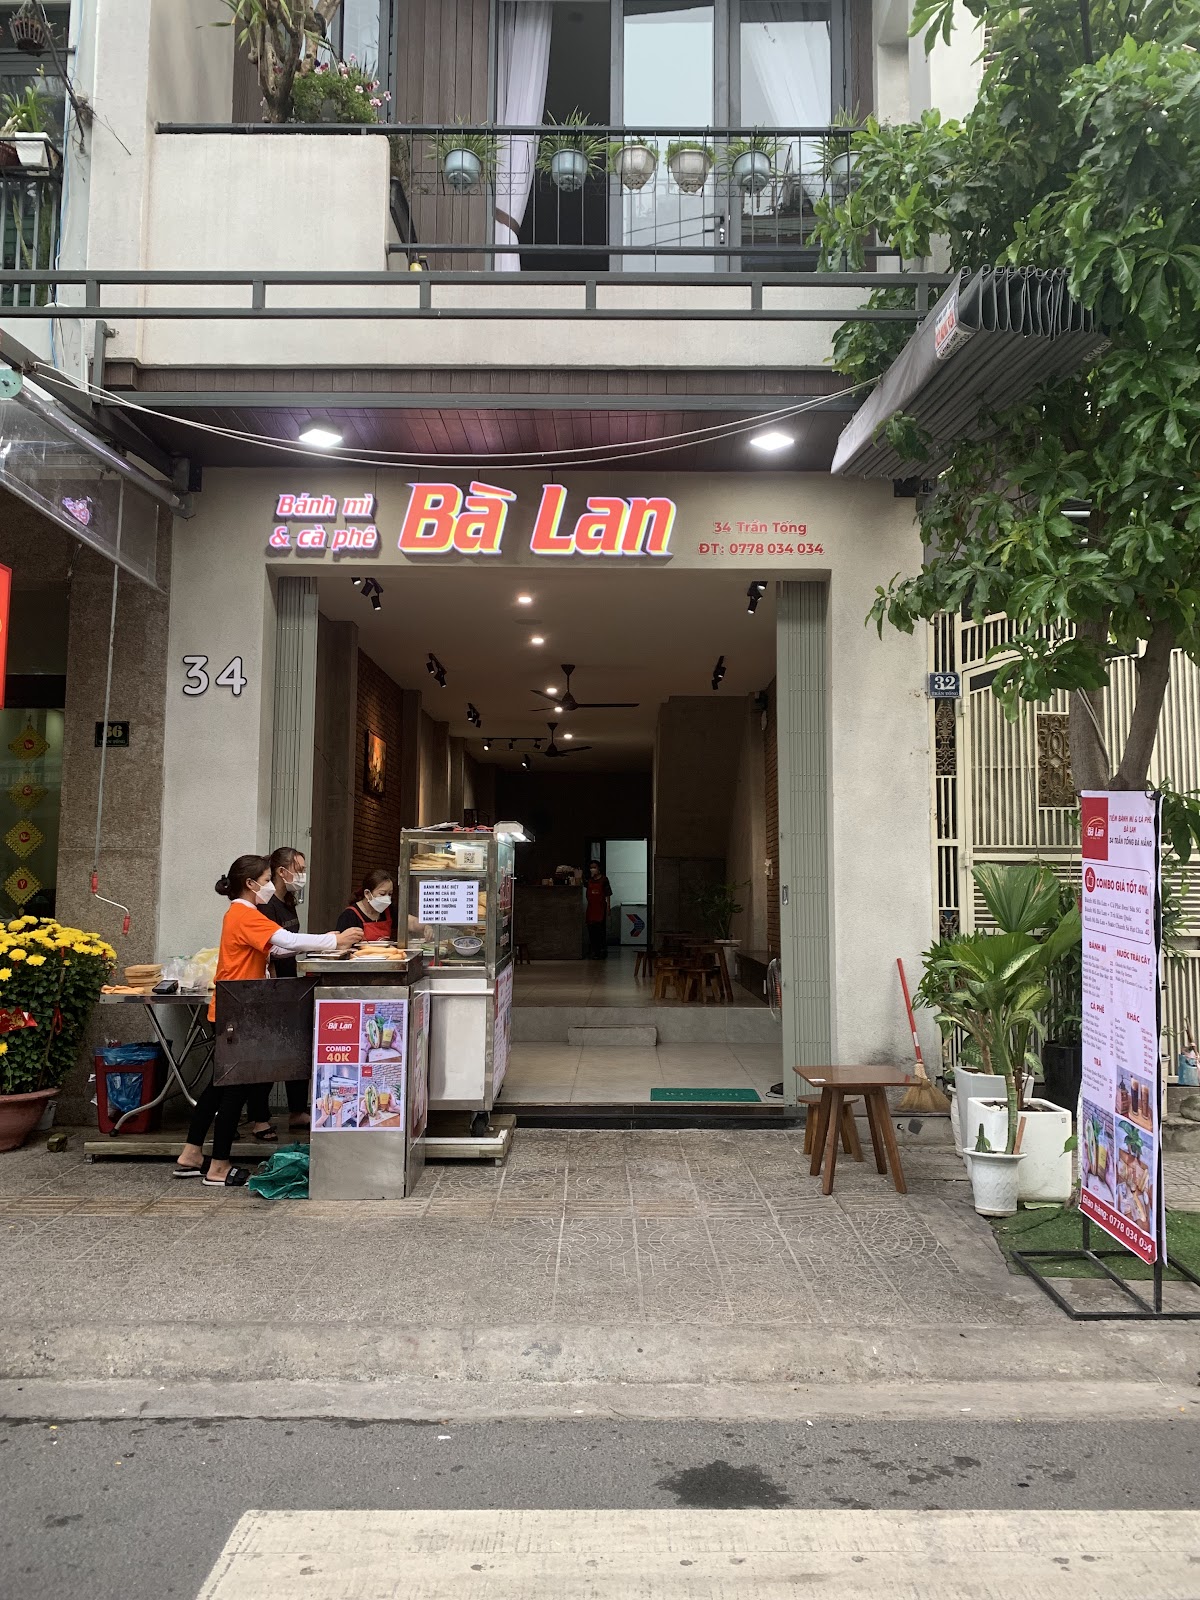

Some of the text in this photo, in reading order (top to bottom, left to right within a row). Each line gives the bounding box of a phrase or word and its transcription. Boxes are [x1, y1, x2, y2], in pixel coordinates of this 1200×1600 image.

[276, 493, 373, 516] Bánh mì
[398, 481, 677, 556] Bà Lan
[714, 522, 732, 533] 34
[772, 520, 807, 536] Tống
[270, 524, 378, 551] & cà phê
[699, 543, 824, 554] ĐT: 0778 034 034
[183, 655, 247, 696] 34
[934, 676, 956, 690] 32
[1095, 827, 1104, 837] Lan
[1097, 878, 1114, 890] COMBO
[1116, 879, 1125, 892] GIÁ
[1127, 879, 1137, 893] TỐT
[1089, 940, 1100, 950] BÁNH
[1131, 953, 1140, 962] TRÁI
[1141, 955, 1150, 965] CÂY
[1091, 1002, 1096, 1010] CÀ
[1127, 1012, 1140, 1023] KHÁC
[327, 1053, 350, 1062] 40K
[1083, 1194, 1094, 1209] Giao
[1109, 1215, 1124, 1232] 0778
[1126, 1227, 1138, 1242] 034
[1139, 1238, 1152, 1253] 034
